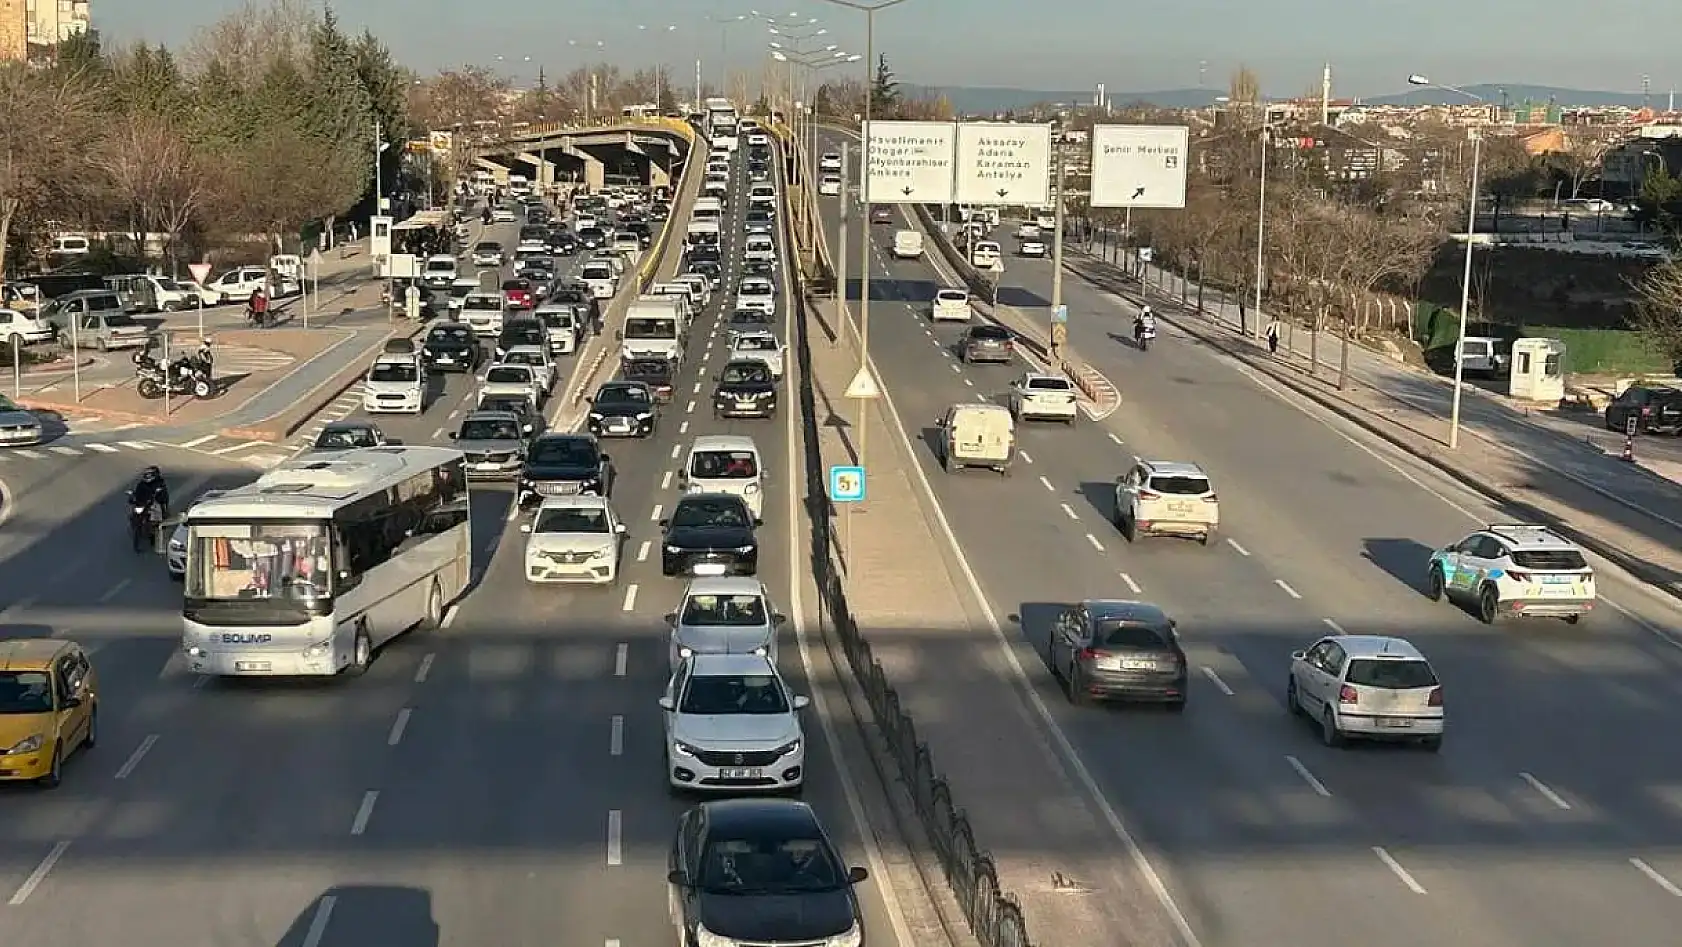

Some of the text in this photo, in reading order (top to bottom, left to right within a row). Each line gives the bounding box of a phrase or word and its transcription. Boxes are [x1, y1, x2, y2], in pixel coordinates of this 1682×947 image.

[978, 138, 1025, 148] Aksaray
[977, 148, 1014, 157] Adana
[976, 159, 1031, 169] Karaman
[869, 167, 911, 177] Ankara
[977, 170, 1022, 181] Antalya
